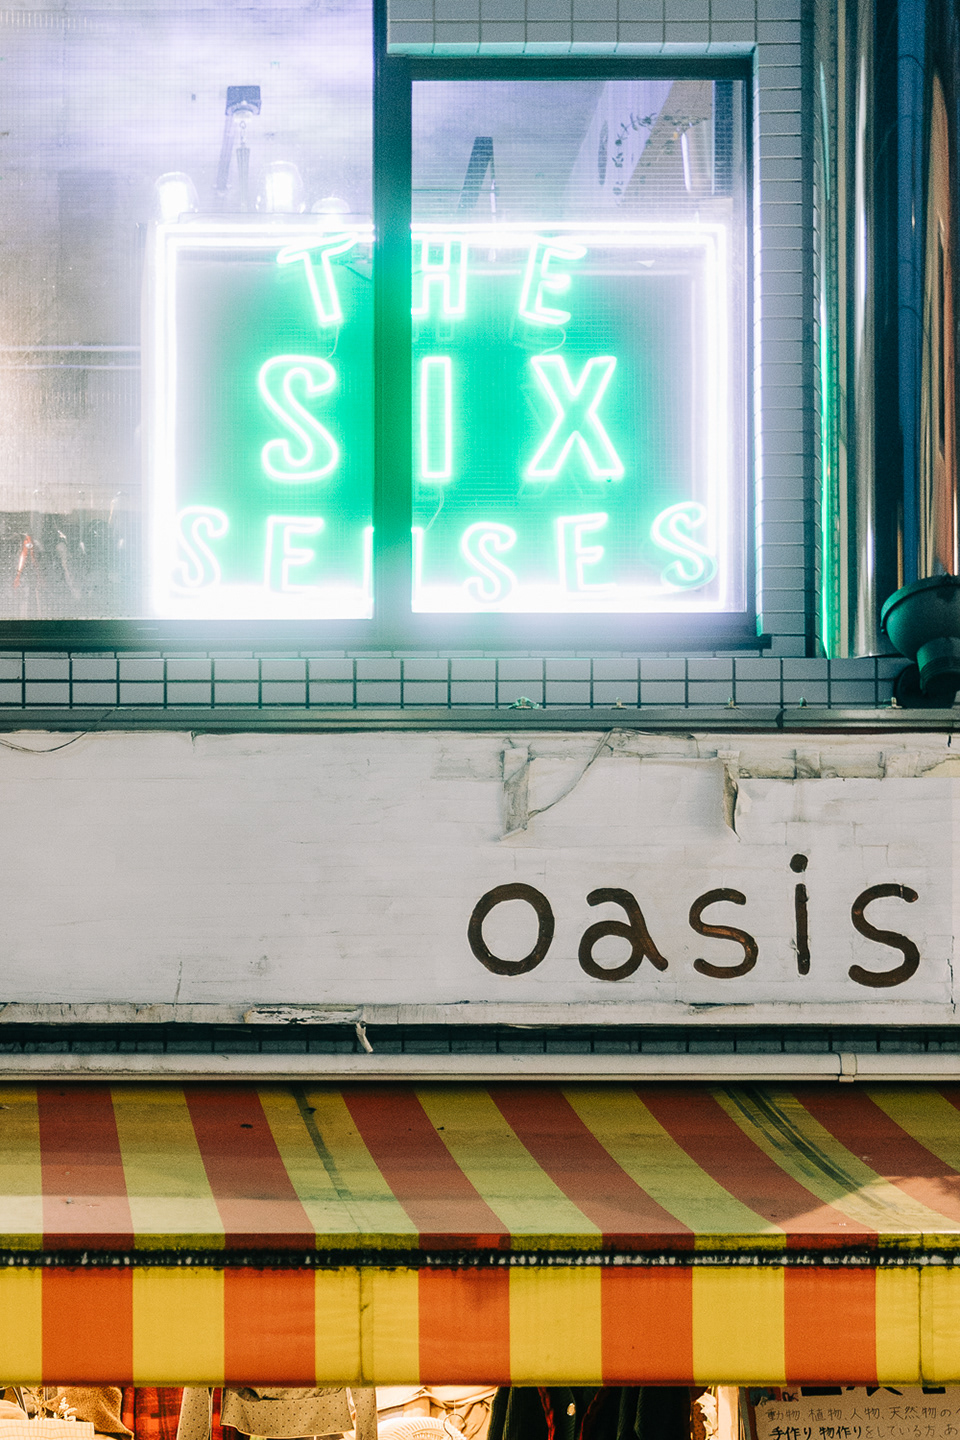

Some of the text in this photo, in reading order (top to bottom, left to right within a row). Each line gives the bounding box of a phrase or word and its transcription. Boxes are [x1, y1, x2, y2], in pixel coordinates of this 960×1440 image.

[276, 232, 588, 326] THE
[257, 353, 625, 482] SIX
[467, 852, 921, 988] oasis
